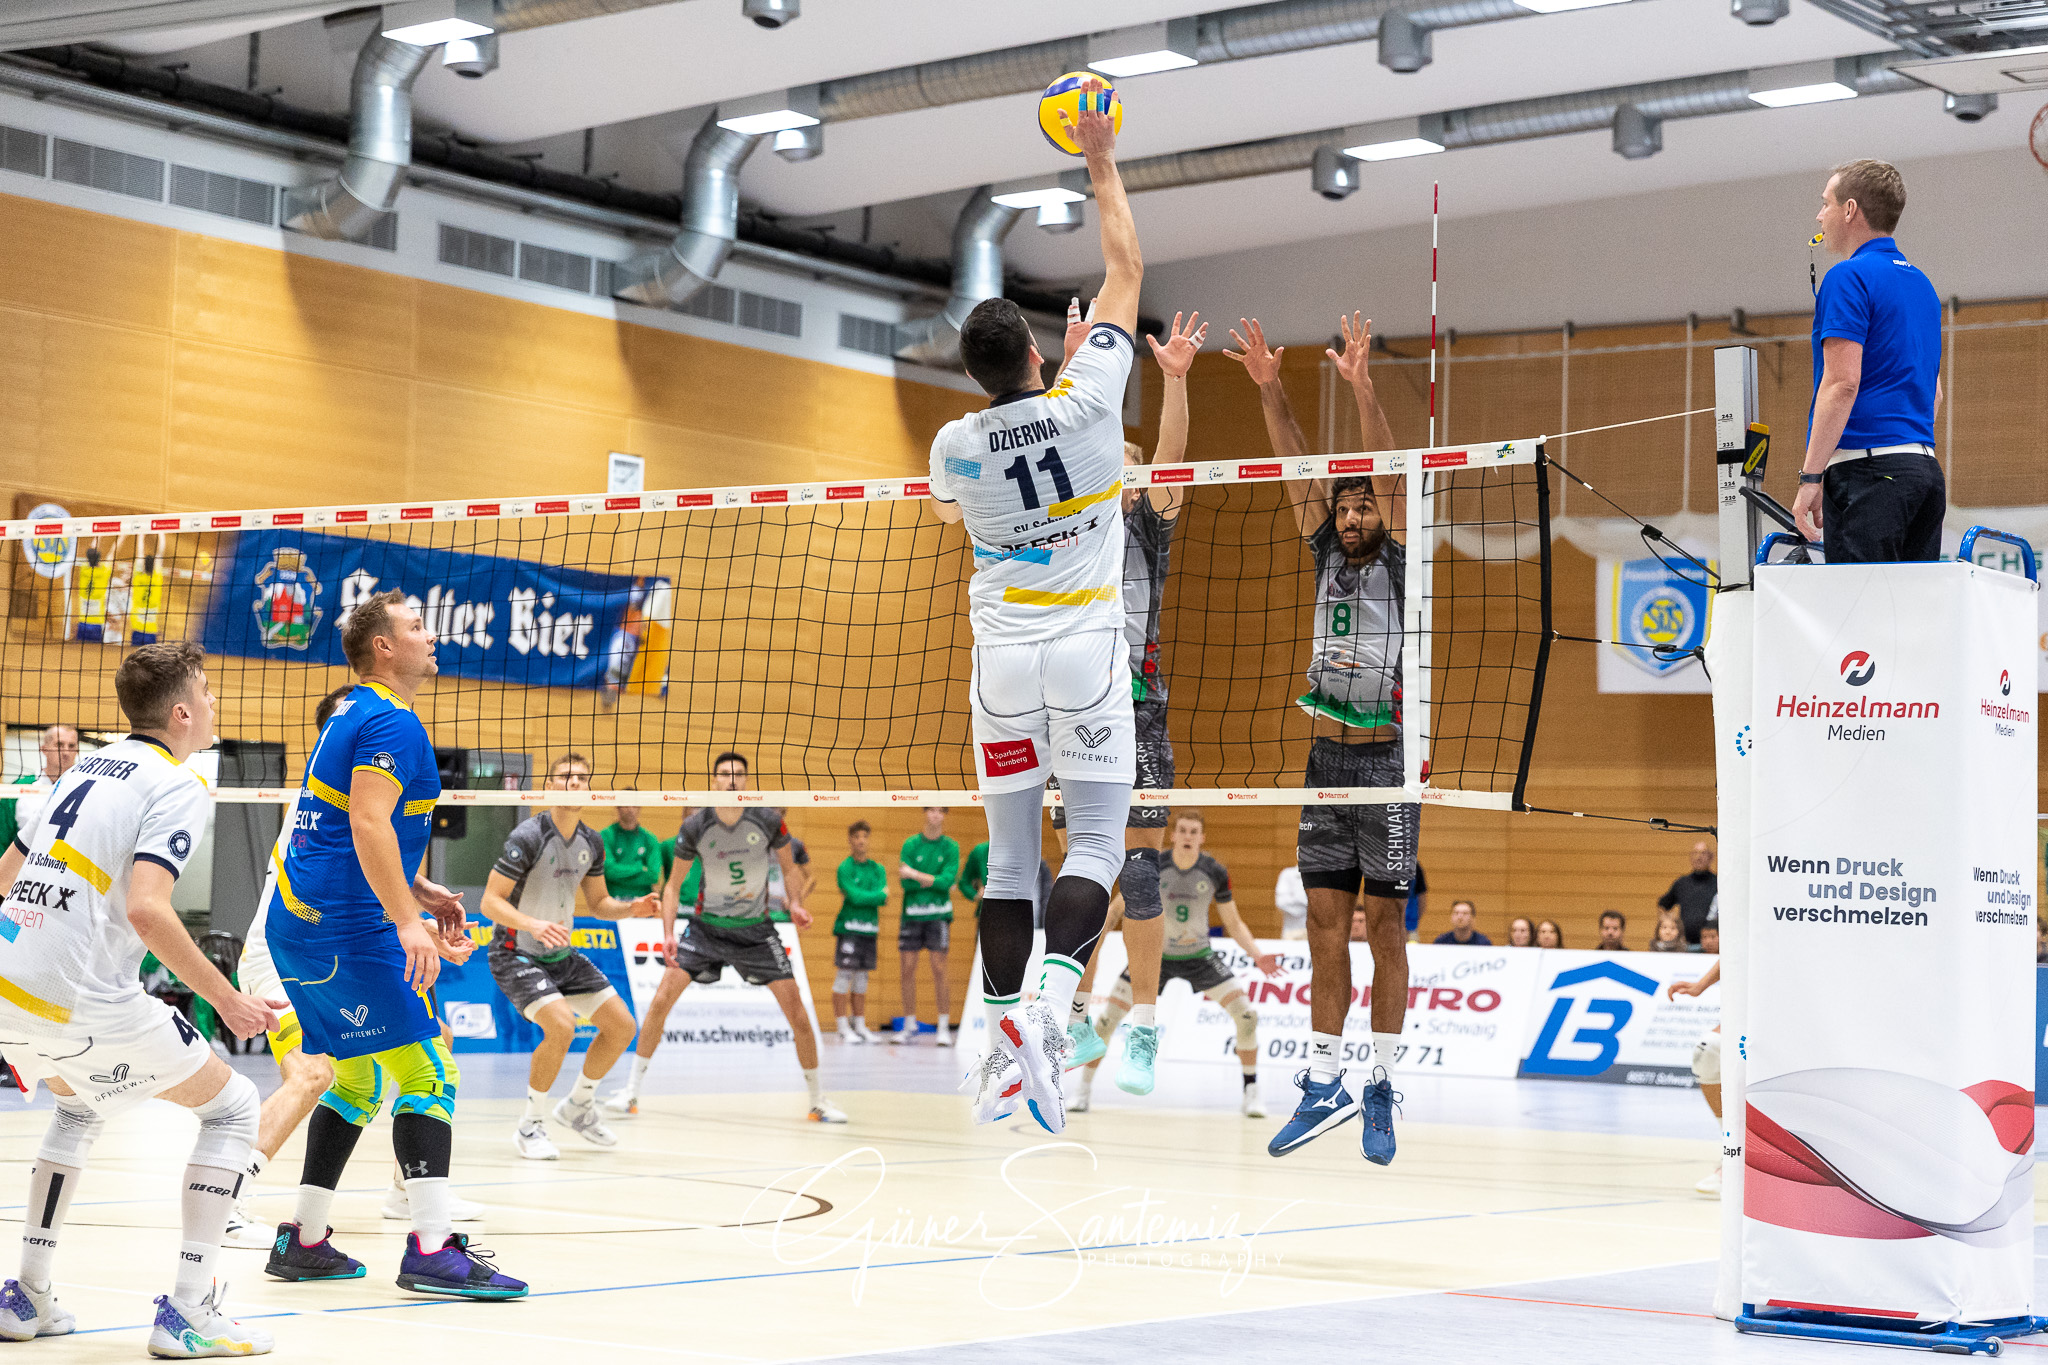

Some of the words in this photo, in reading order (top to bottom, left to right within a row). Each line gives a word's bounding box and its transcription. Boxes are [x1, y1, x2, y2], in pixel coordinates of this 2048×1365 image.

[989, 417, 1061, 453] DZIERWA
[1003, 446, 1075, 511] 11
[508, 586, 594, 661] Bier
[1331, 602, 1352, 637] 8
[1775, 694, 1941, 719] Heinzelmann
[1980, 698, 2030, 723] Heinzelmann
[1827, 724, 1886, 741] Medien
[1994, 723, 2015, 738] Medien
[994, 746, 1027, 760] Sparkasse
[996, 756, 1028, 768] Nürnberg
[1061, 749, 1119, 764] OFFICEWELT
[1146, 792, 1170, 800] Marmot
[1234, 792, 1258, 800] Marmot
[1324, 791, 1349, 799] Marmot
[49, 779, 97, 840] 4
[35, 852, 68, 874] Schwaig
[729, 862, 745, 880] 5
[1767, 854, 1831, 875] Wenn
[1836, 857, 1904, 877] Druck
[1972, 866, 1999, 883] Wenn
[1999, 868, 2021, 886] Druck
[1807, 881, 1853, 900] und
[1859, 882, 1938, 909] Design
[1987, 890, 2006, 905] und
[2006, 890, 2032, 911] Design
[1176, 905, 1189, 923] 9
[1773, 904, 1929, 927] verschmelzen
[1975, 908, 2029, 927] verschmelzen
[1452, 957, 1508, 981] Gino
[172, 1011, 200, 1047] 4
[340, 1025, 388, 1041] OFFICEWELT
[1417, 1045, 1444, 1066] 71
[206, 1185, 232, 1197] cep
